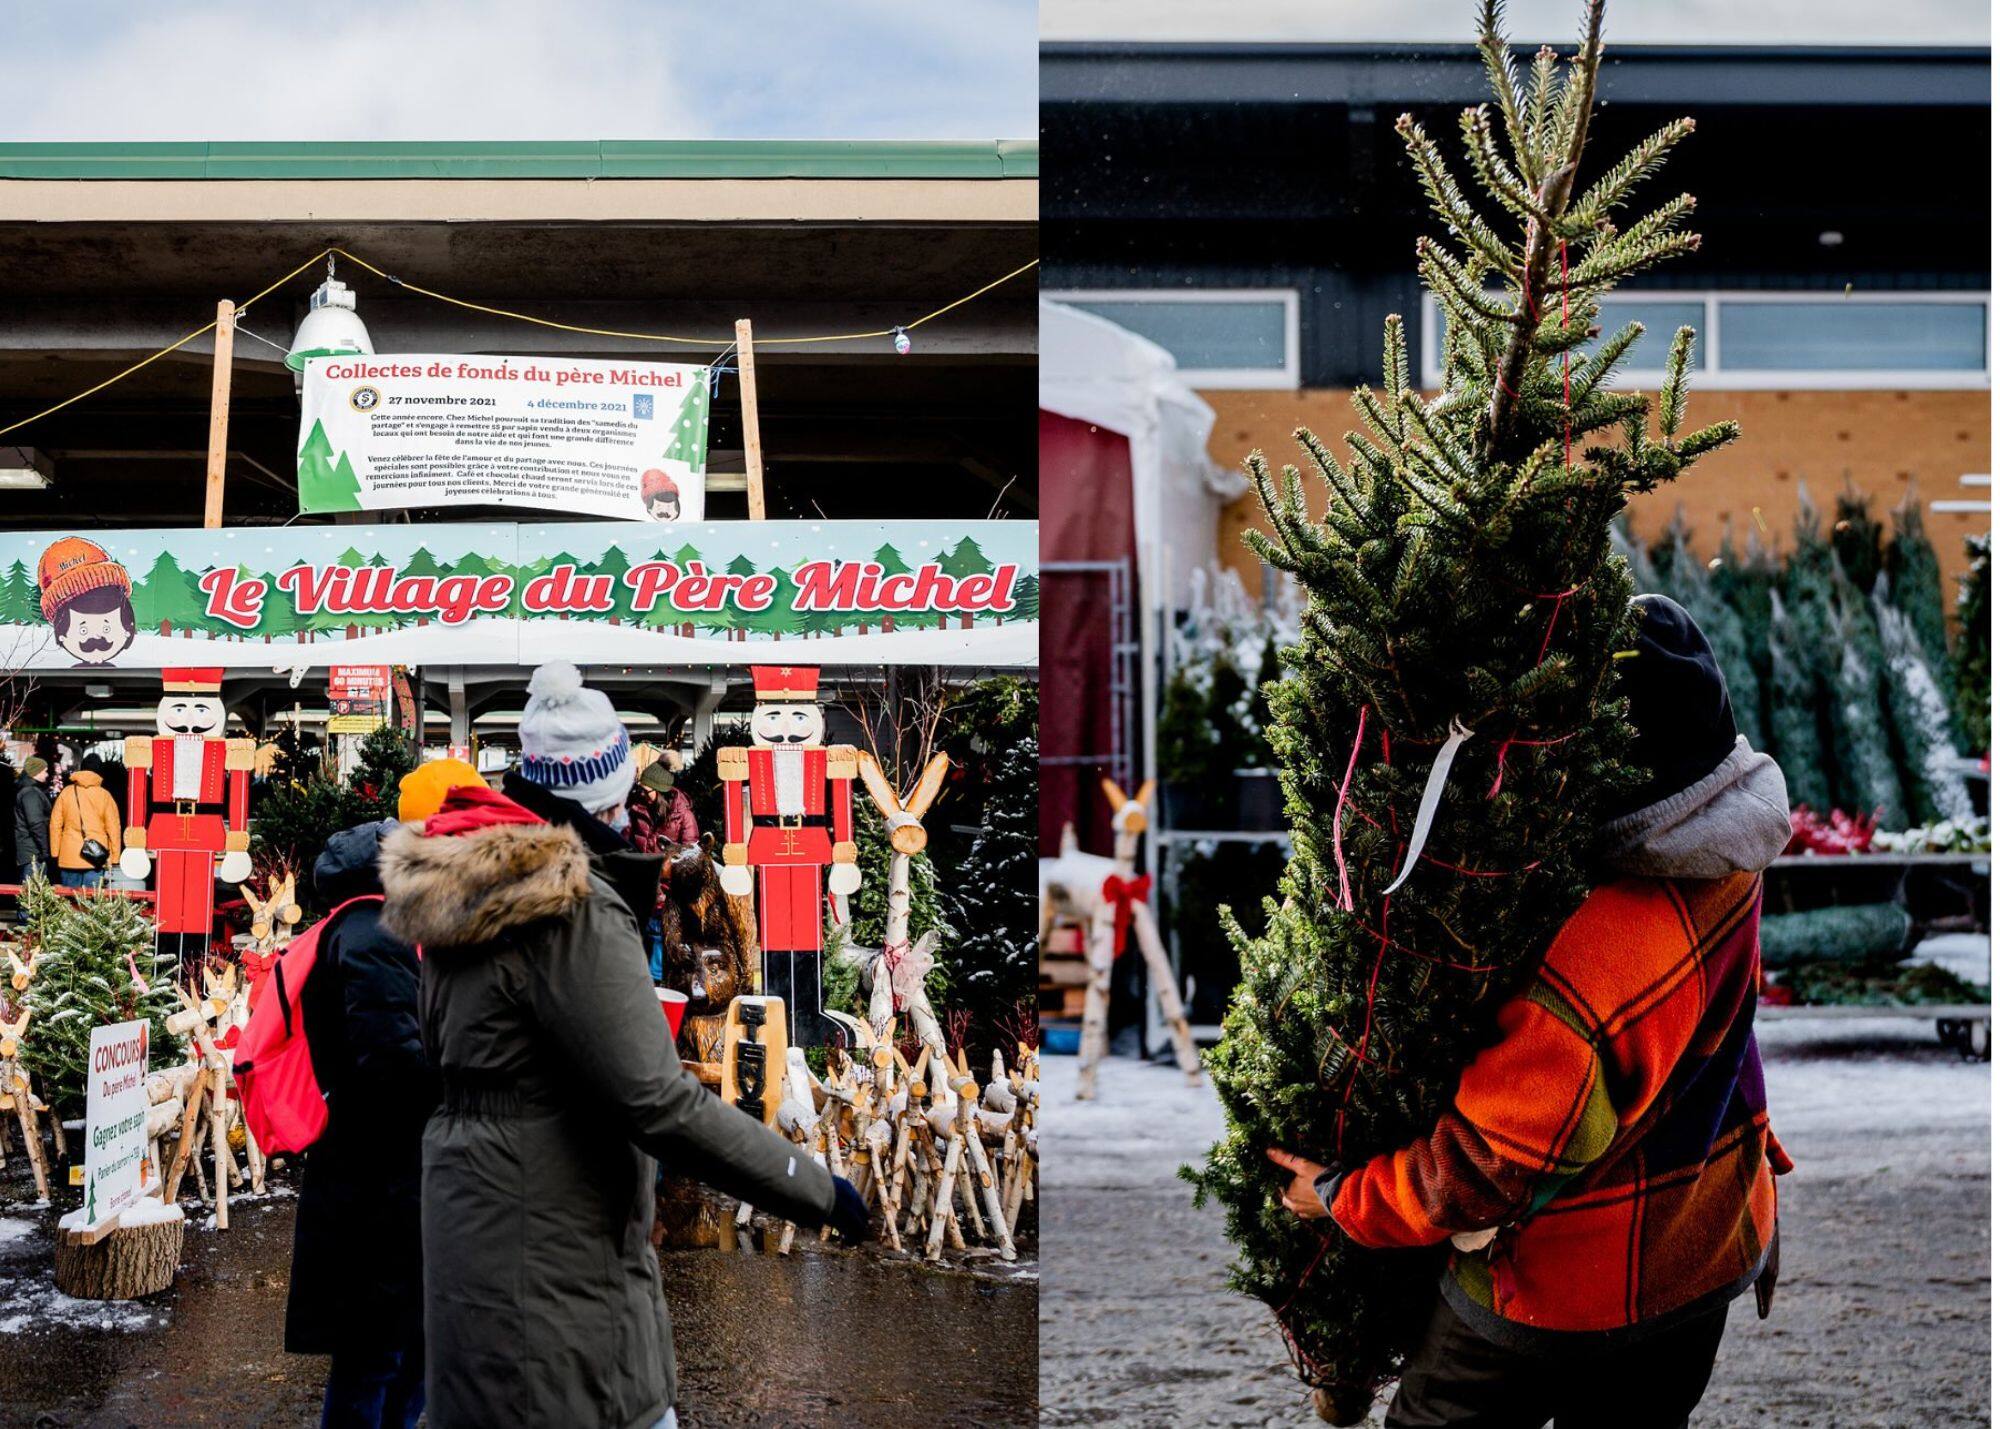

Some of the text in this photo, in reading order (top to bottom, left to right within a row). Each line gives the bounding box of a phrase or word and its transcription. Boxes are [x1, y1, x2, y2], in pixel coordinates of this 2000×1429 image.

[326, 363, 682, 388] Collectes de fonds du père Michel
[388, 396, 402, 405] 27
[405, 395, 467, 406] novembre
[470, 397, 496, 406] 2021
[537, 399, 598, 410] décembre
[601, 402, 627, 412] 2021
[495, 415, 528, 423] poursuit
[541, 417, 576, 425] tradition
[400, 430, 413, 438] qui
[517, 432, 531, 440] qui
[532, 432, 549, 440] font
[595, 436, 634, 446] différence
[416, 422, 448, 430] s'engage
[456, 422, 490, 430] remettre
[540, 425, 564, 433] vendu
[571, 426, 591, 434] deux
[592, 428, 637, 438] organismes
[524, 440, 552, 448] jeunes.
[374, 463, 409, 471] spéciales
[429, 462, 466, 470] possibles
[467, 463, 488, 471] grâce
[520, 464, 570, 474] contribution
[463, 454, 493, 462] l'amour
[605, 462, 638, 473] journées
[411, 471, 454, 479] infiniment.
[486, 471, 519, 479] chocolat
[521, 473, 545, 481] chaud
[547, 475, 573, 483] seront
[574, 477, 598, 486] servis
[599, 479, 614, 487] lors
[373, 481, 407, 491] journées
[408, 480, 427, 488] pour
[529, 482, 550, 490] votre
[552, 484, 579, 492] grande
[580, 486, 624, 497] générosité
[59, 554, 86, 570] Michel
[201, 561, 1020, 628] Le Village du Père Michel
[333, 677, 384, 687] 60 MINUTES
[95, 1038, 140, 1073] CONCOURS
[93, 1110, 145, 1150] Gagnez votre sapin
